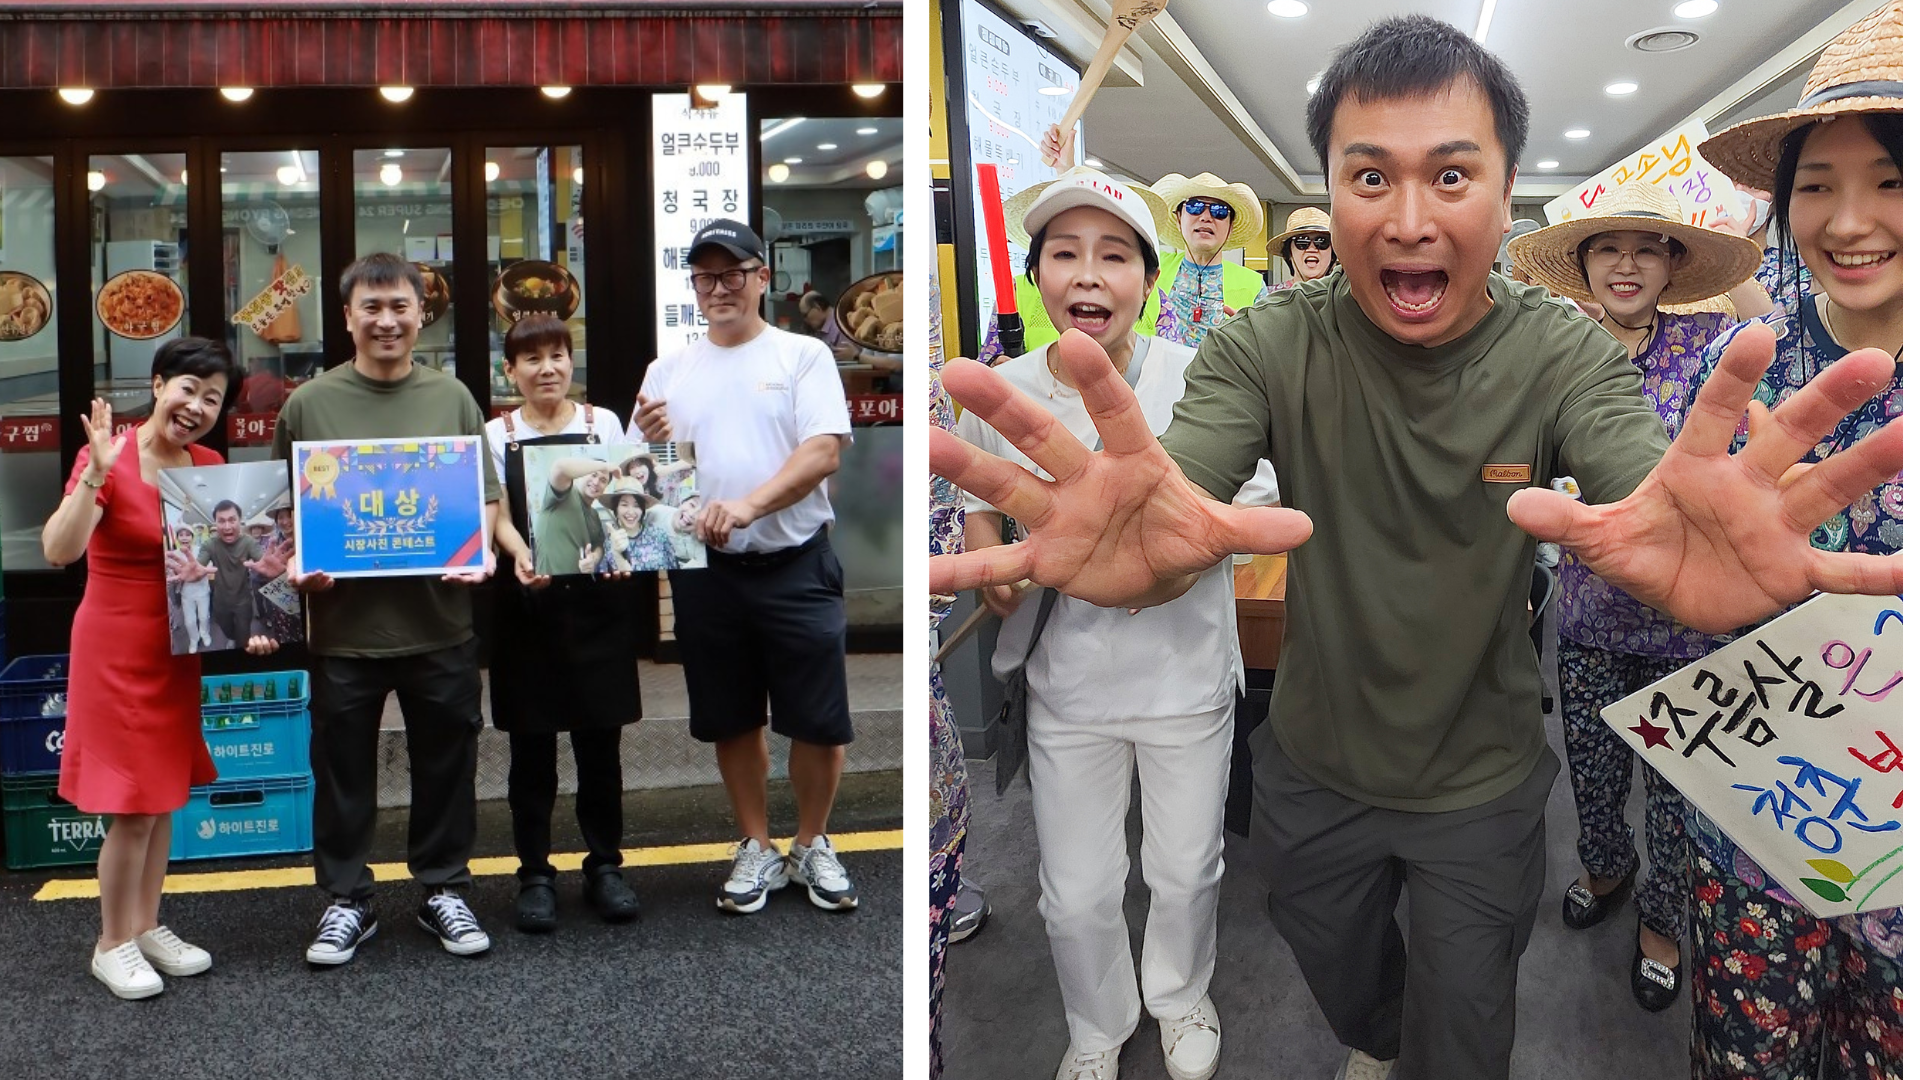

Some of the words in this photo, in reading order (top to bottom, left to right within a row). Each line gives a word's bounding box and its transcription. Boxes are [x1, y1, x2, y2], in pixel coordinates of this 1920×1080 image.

[661, 132, 740, 156] 얼큰순두부
[0, 425, 39, 442] 구찜
[344, 538, 389, 551] 시장사진
[391, 535, 436, 549] 콘테스트
[1650, 639, 1845, 767] 주름살
[214, 742, 275, 758] 하이트진로
[48, 815, 107, 842] TERRA
[219, 819, 280, 835] 하이트진로
